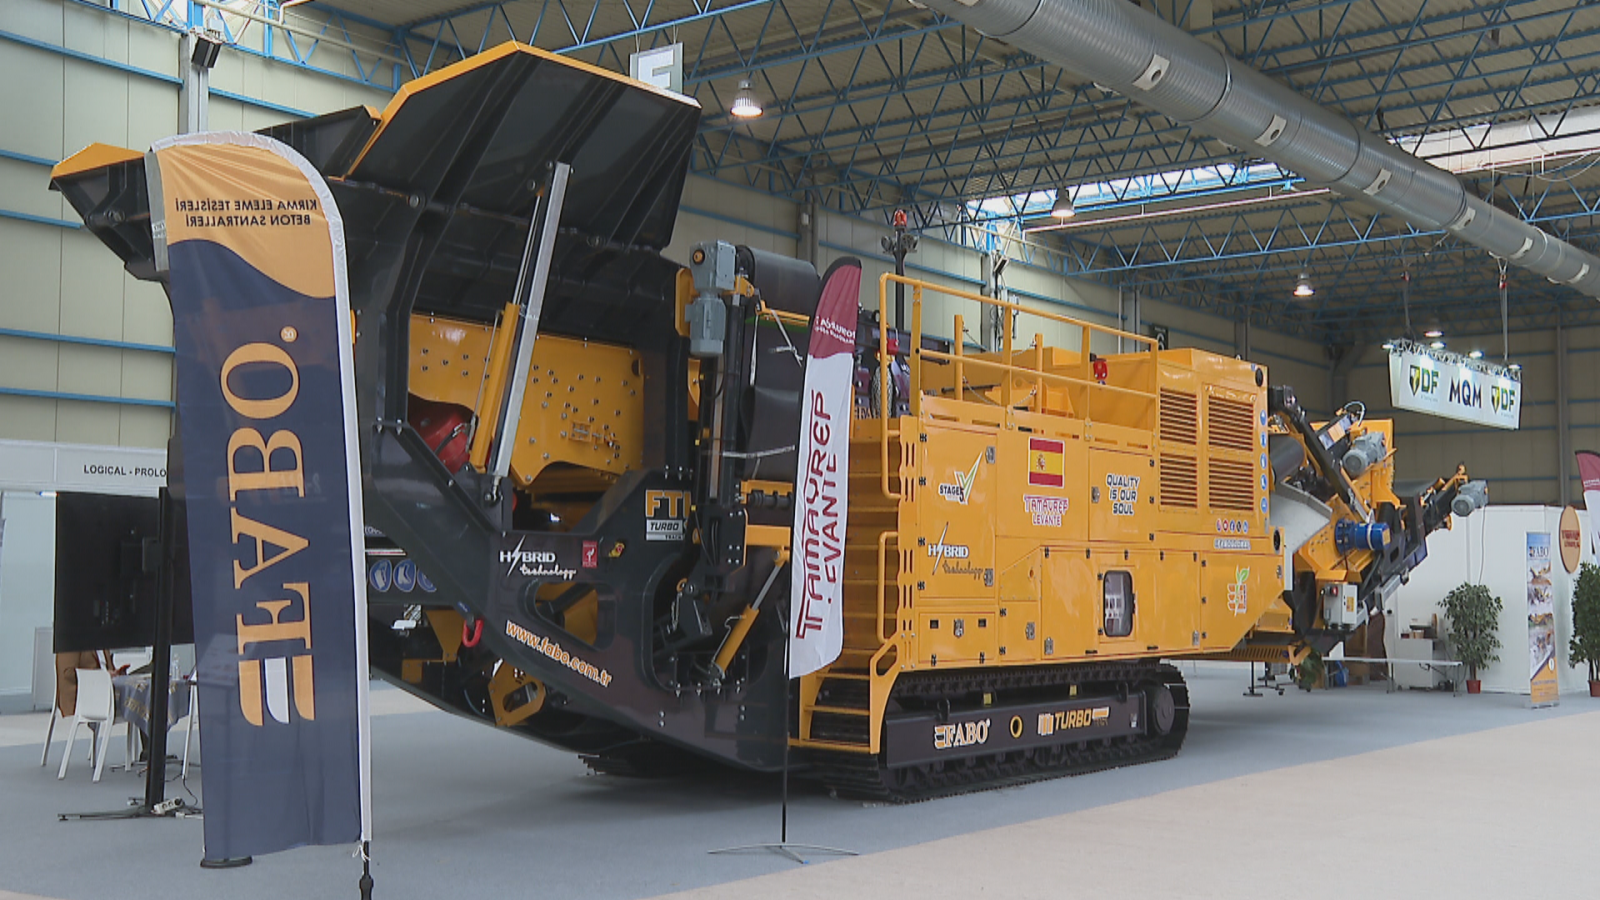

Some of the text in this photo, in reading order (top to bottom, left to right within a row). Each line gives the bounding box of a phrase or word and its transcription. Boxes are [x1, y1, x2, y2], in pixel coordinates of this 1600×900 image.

[1421, 367, 1516, 412] DF MQM DF
[83, 464, 127, 476] LOGICAL
[1106, 474, 1140, 488] QUALITY
[939, 484, 960, 496] STAGE
[1109, 489, 1138, 502] IS OUR
[1112, 502, 1135, 516] SOUL
[650, 521, 680, 531] TURBO
[1032, 513, 1063, 527] LEVANTE
[505, 619, 613, 688] www.fabo.com.tr
[1054, 708, 1092, 731] TURBO
[944, 720, 990, 748] FABO
